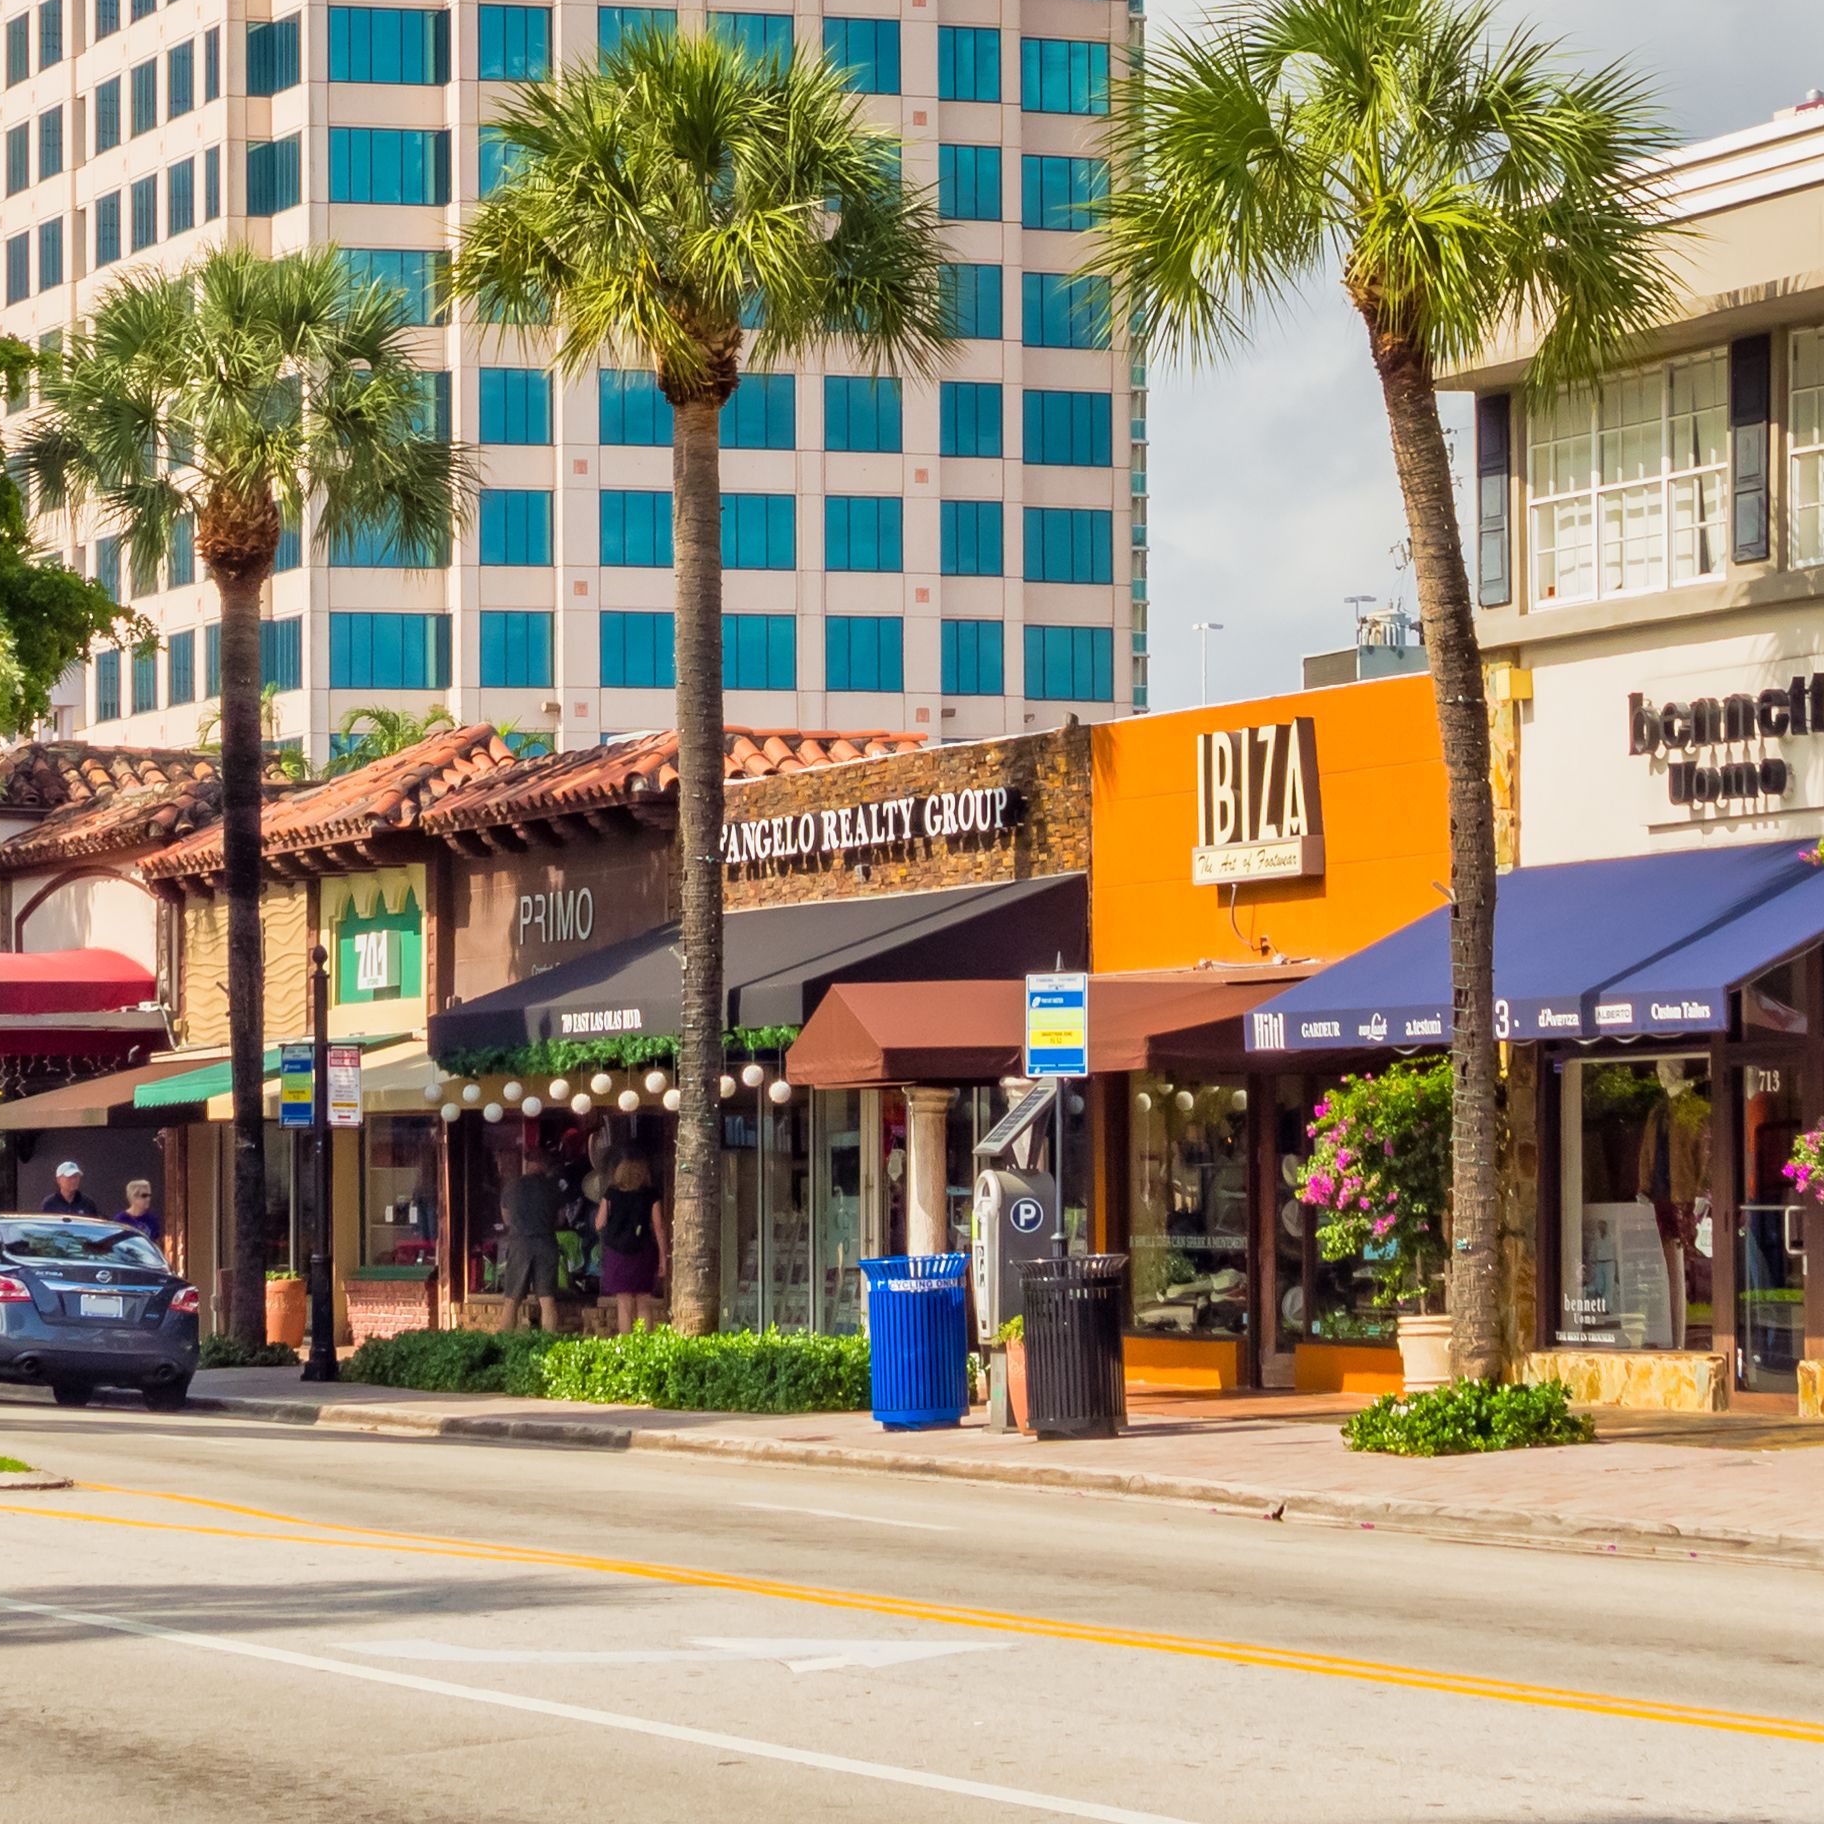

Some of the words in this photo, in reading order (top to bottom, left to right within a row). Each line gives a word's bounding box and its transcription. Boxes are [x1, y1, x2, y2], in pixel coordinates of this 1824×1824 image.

[1197, 719, 1308, 847] IBIZA
[1668, 758, 1788, 806] Uomo
[719, 813, 815, 863] 'ANGELO
[821, 797, 915, 852] REALTY
[925, 787, 1007, 837] GROUP
[1198, 856, 1213, 874] The
[1219, 853, 1236, 873] Art
[1243, 852, 1253, 873] of
[1257, 849, 1297, 869] Footwear
[519, 887, 594, 945] PRIMO
[573, 1012, 590, 1033] EAST
[590, 1011, 604, 1031] LAS
[604, 1009, 623, 1032] OLAS
[1597, 1008, 1631, 1022] ALBERTO
[1651, 1003, 1681, 1020] Custom
[1682, 1002, 1711, 1019] Tailors
[1253, 1012, 1285, 1050] Hiltl
[1301, 1020, 1340, 1038] GARDEUR
[1406, 1012, 1442, 1036] a.testoni
[1758, 1070, 1780, 1093] 713
[1019, 1203, 1037, 1227] P
[1564, 1293, 1607, 1313] bennett
[1573, 1313, 1597, 1325] Uomo
